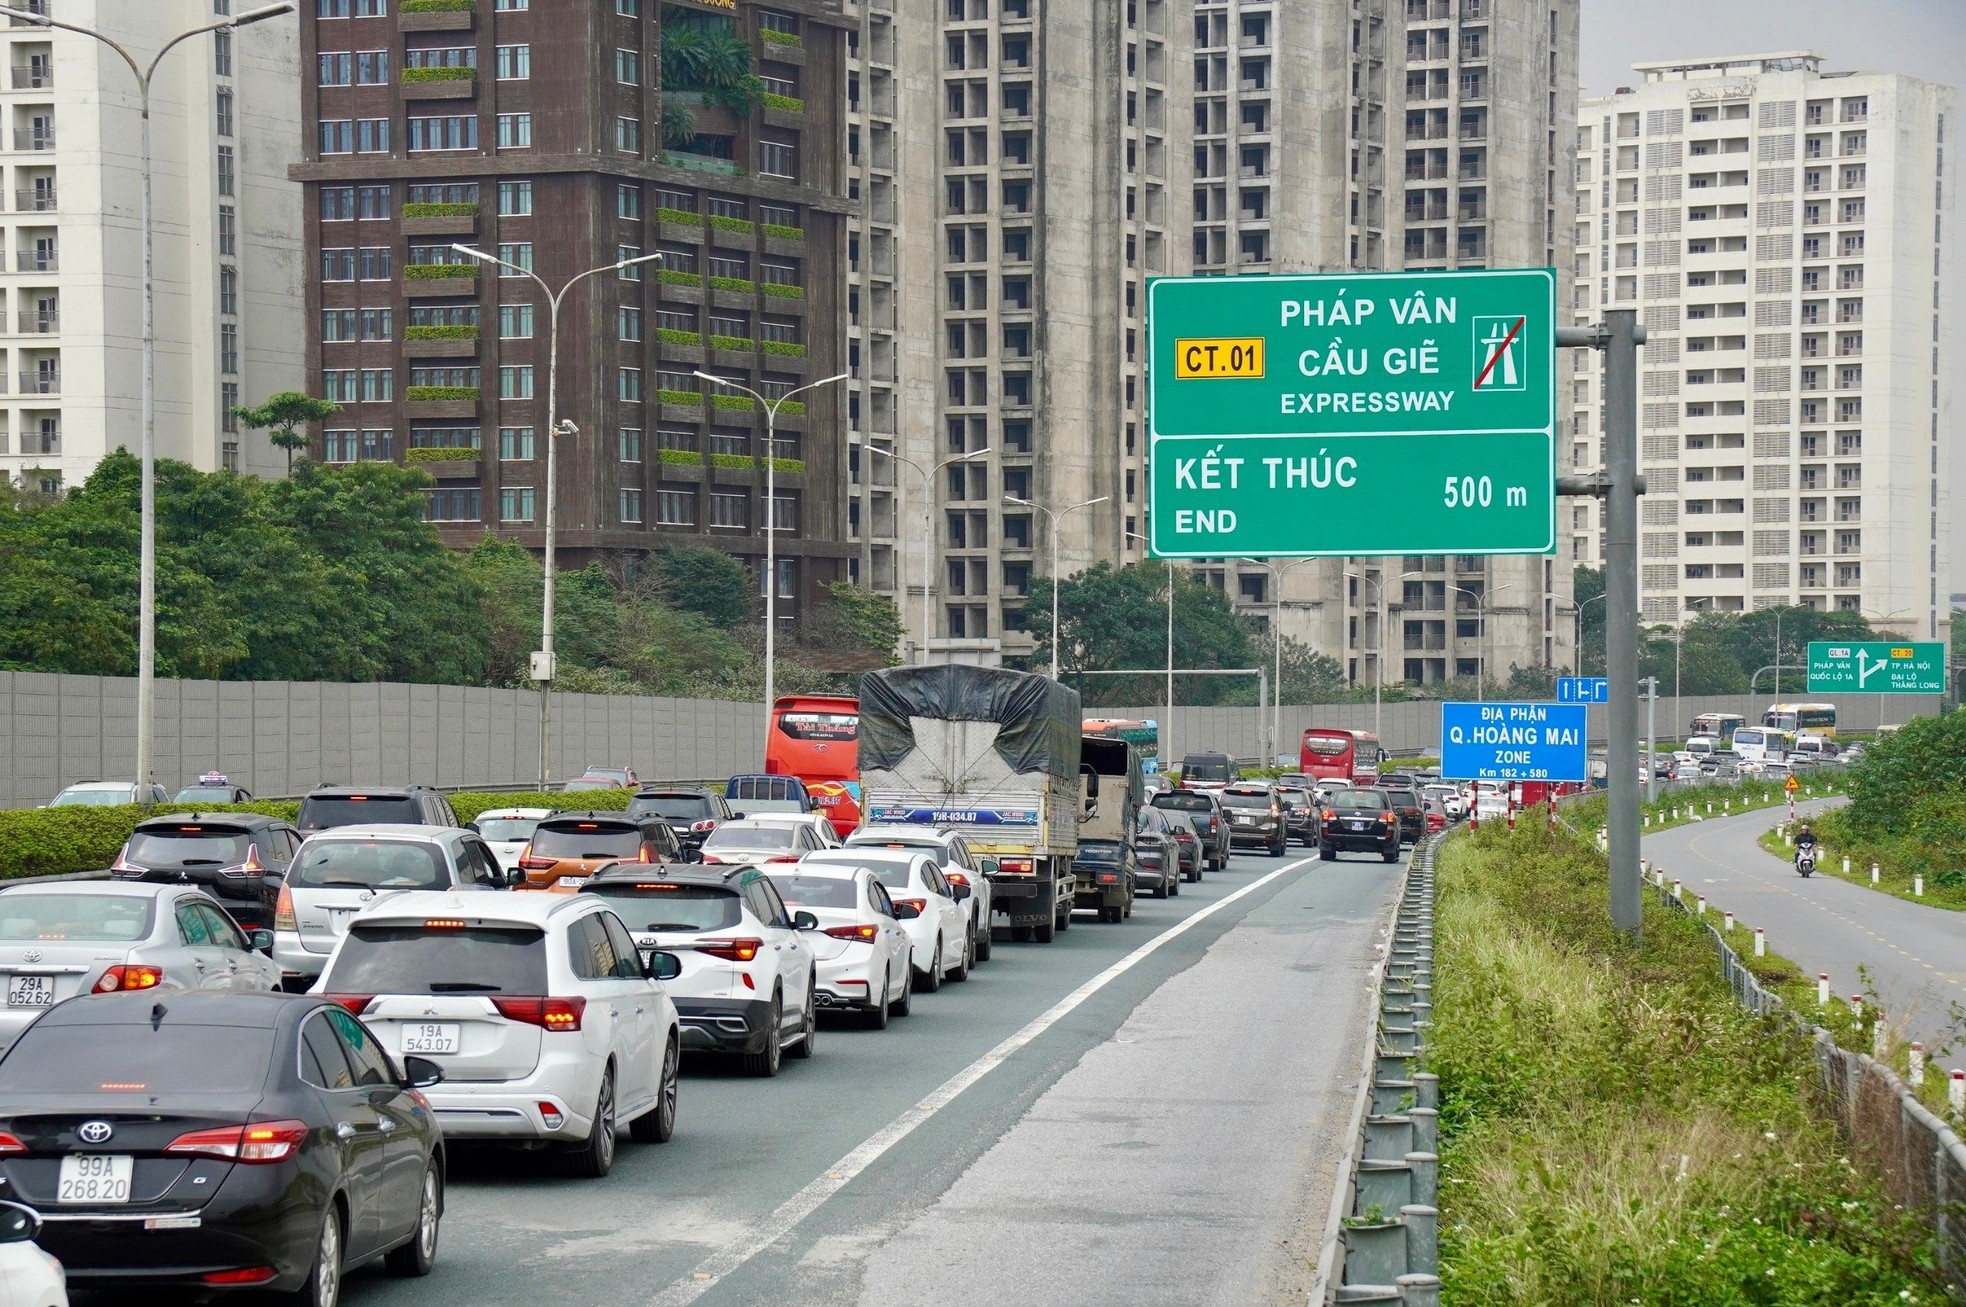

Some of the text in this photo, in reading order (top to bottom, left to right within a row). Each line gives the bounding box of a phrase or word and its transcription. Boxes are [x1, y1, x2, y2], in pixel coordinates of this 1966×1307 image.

[1281, 288, 1457, 327] PHÁP VÂN
[1185, 345, 1255, 372] CT.01
[1299, 337, 1440, 376] CẦU GIẼ
[1281, 390, 1455, 414] EXPRESSWAY
[1175, 445, 1358, 489] KẾT THÚC
[1444, 476, 1527, 508] 500 m
[1175, 509, 1237, 534] END
[1814, 661, 1851, 669] PHÁP VÂN
[1917, 661, 1930, 671] NỘI
[1810, 671, 1831, 680] QUỐC
[1832, 672, 1842, 681] LỘ
[1481, 705, 1546, 724] ĐỊA PHẬN
[1546, 728, 1578, 745] MAI
[1495, 751, 1531, 764] ZONE
[1480, 768, 1496, 777] Km
[1500, 768, 1517, 778] 182
[1530, 768, 1548, 778] 580
[20, 978, 43, 991] 29A
[10, 991, 51, 1005] 052.62
[420, 1025, 442, 1037] 19A
[407, 1038, 453, 1051] 543.07
[79, 1157, 113, 1177] 99A
[193, 1176, 207, 1184] G
[61, 1179, 126, 1199] 268.20
